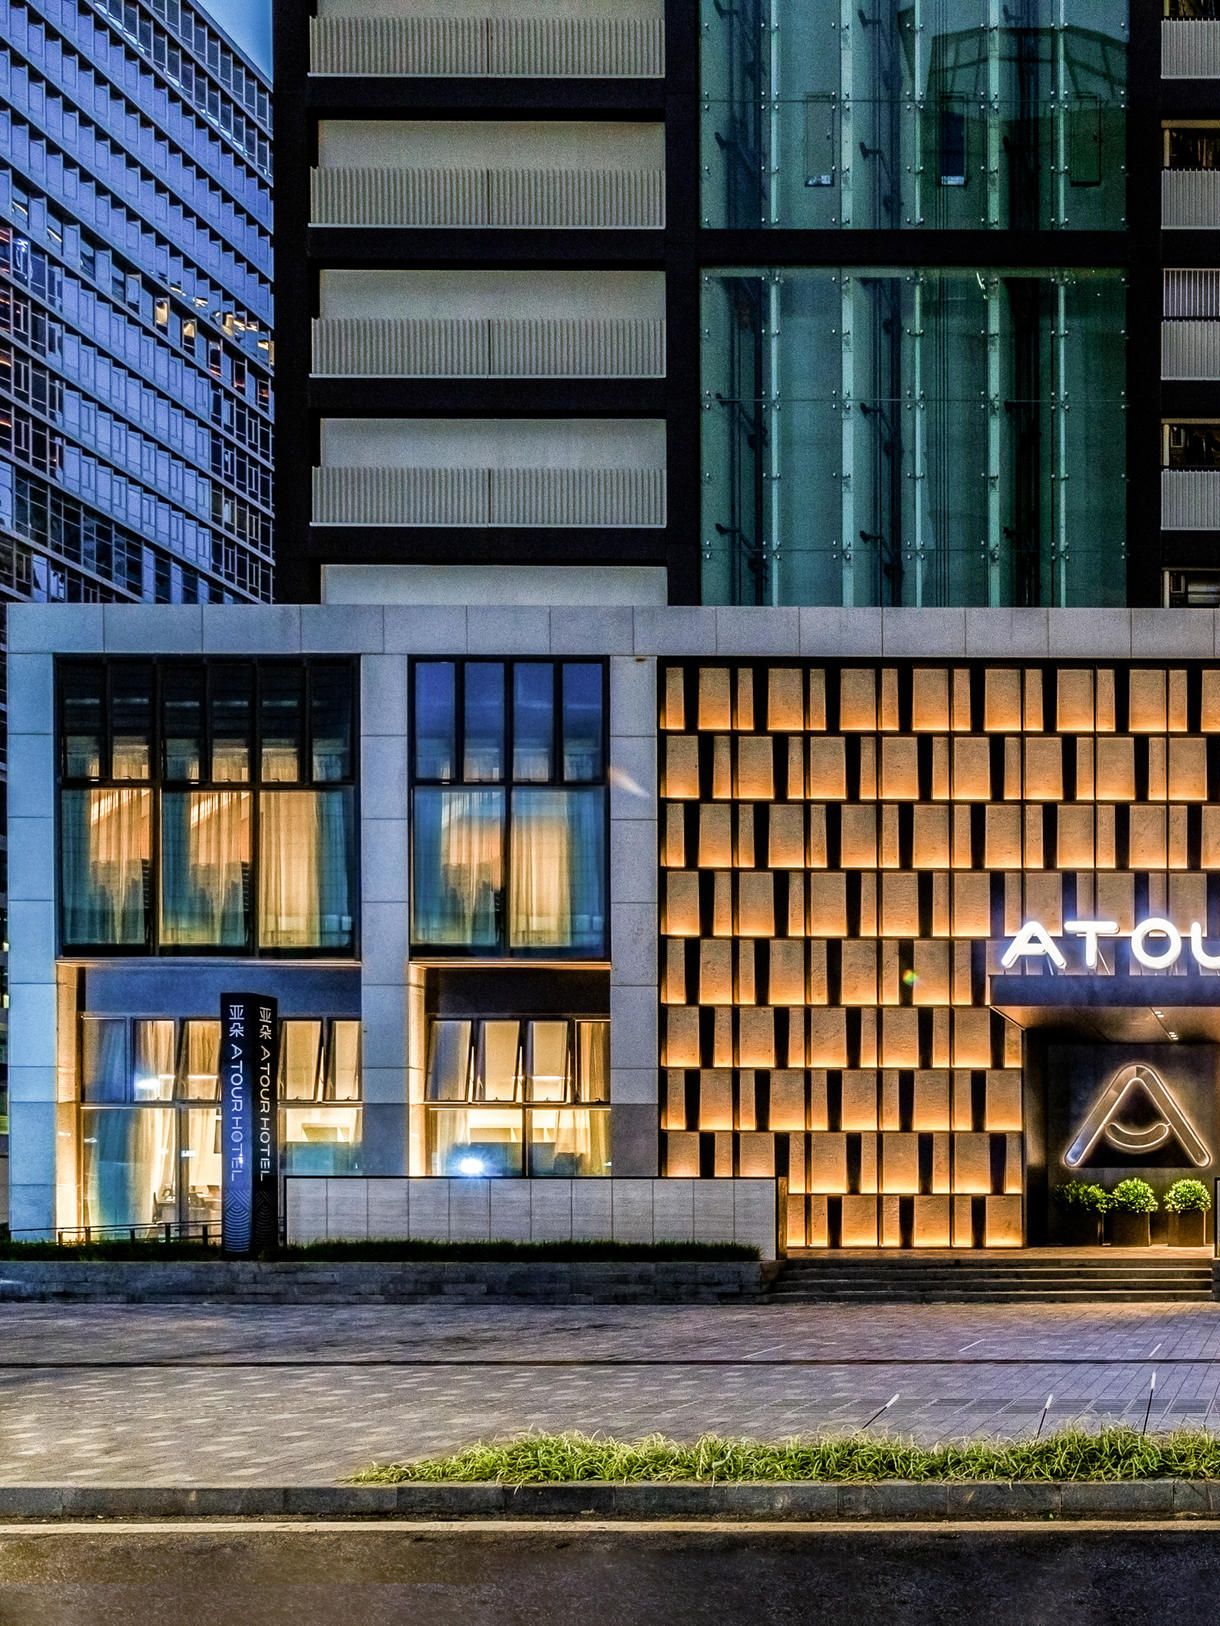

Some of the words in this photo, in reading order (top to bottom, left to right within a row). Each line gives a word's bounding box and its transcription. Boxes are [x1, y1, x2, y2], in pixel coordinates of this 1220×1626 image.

[229, 1005, 245, 1038] 亚朵
[259, 1007, 272, 1040] 亚朵
[231, 1044, 243, 1112] ATOUR
[260, 1045, 270, 1113] ATOUR
[231, 1116, 243, 1182] HOTEL
[260, 1117, 270, 1182] HOTEL
